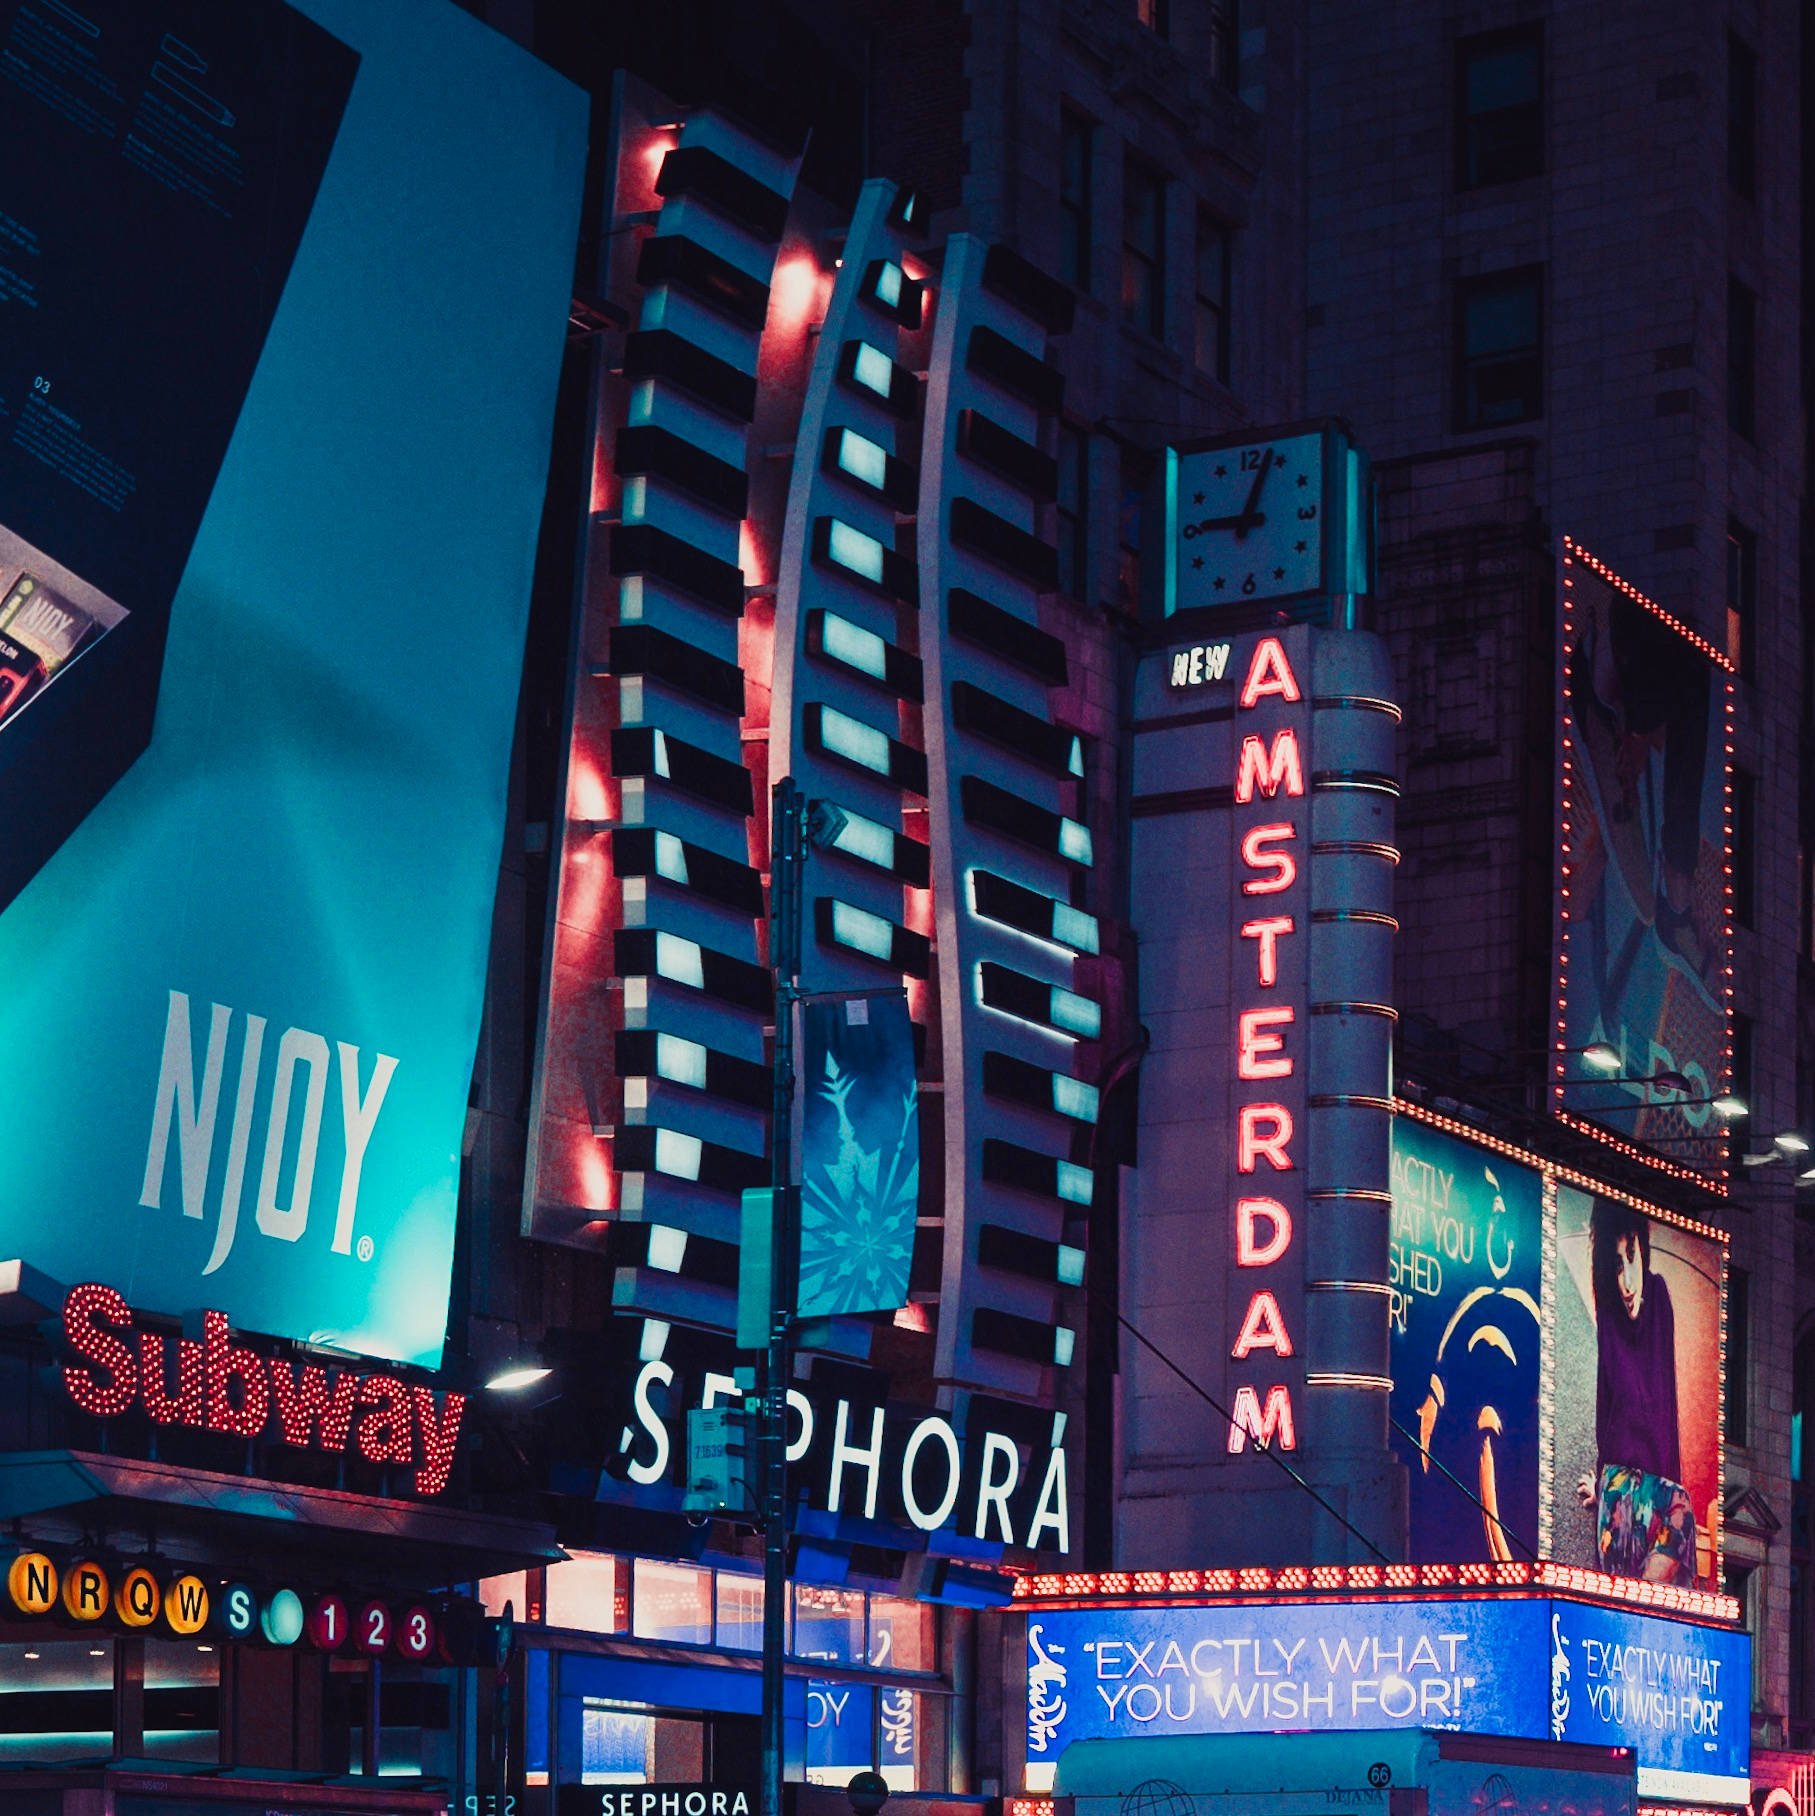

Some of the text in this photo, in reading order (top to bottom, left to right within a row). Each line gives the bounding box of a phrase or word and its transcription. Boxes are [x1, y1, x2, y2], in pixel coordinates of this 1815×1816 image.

[34, 376, 52, 394] 03
[1240, 450, 1260, 471] 12
[1243, 573, 1256, 594] 6
[20, 596, 74, 640] NJOY
[1171, 643, 1230, 687] NEW
[1227, 636, 1305, 1453] AMSTERDAM
[138, 988, 400, 1276] NJOY
[1432, 1212, 1474, 1264] YOU
[62, 1281, 468, 1496] Subway
[27, 1565, 428, 1651] N R Q W S 1 2 3
[1318, 1634, 1469, 1675] WHAT
[1670, 1655, 1722, 1696] WHAT
[1096, 1682, 1196, 1723] YOU
[1214, 1681, 1334, 1721] WISH
[1588, 1684, 1626, 1724] YOU
[1632, 1692, 1675, 1730] WISH
[1370, 1766, 1389, 1784] 66
